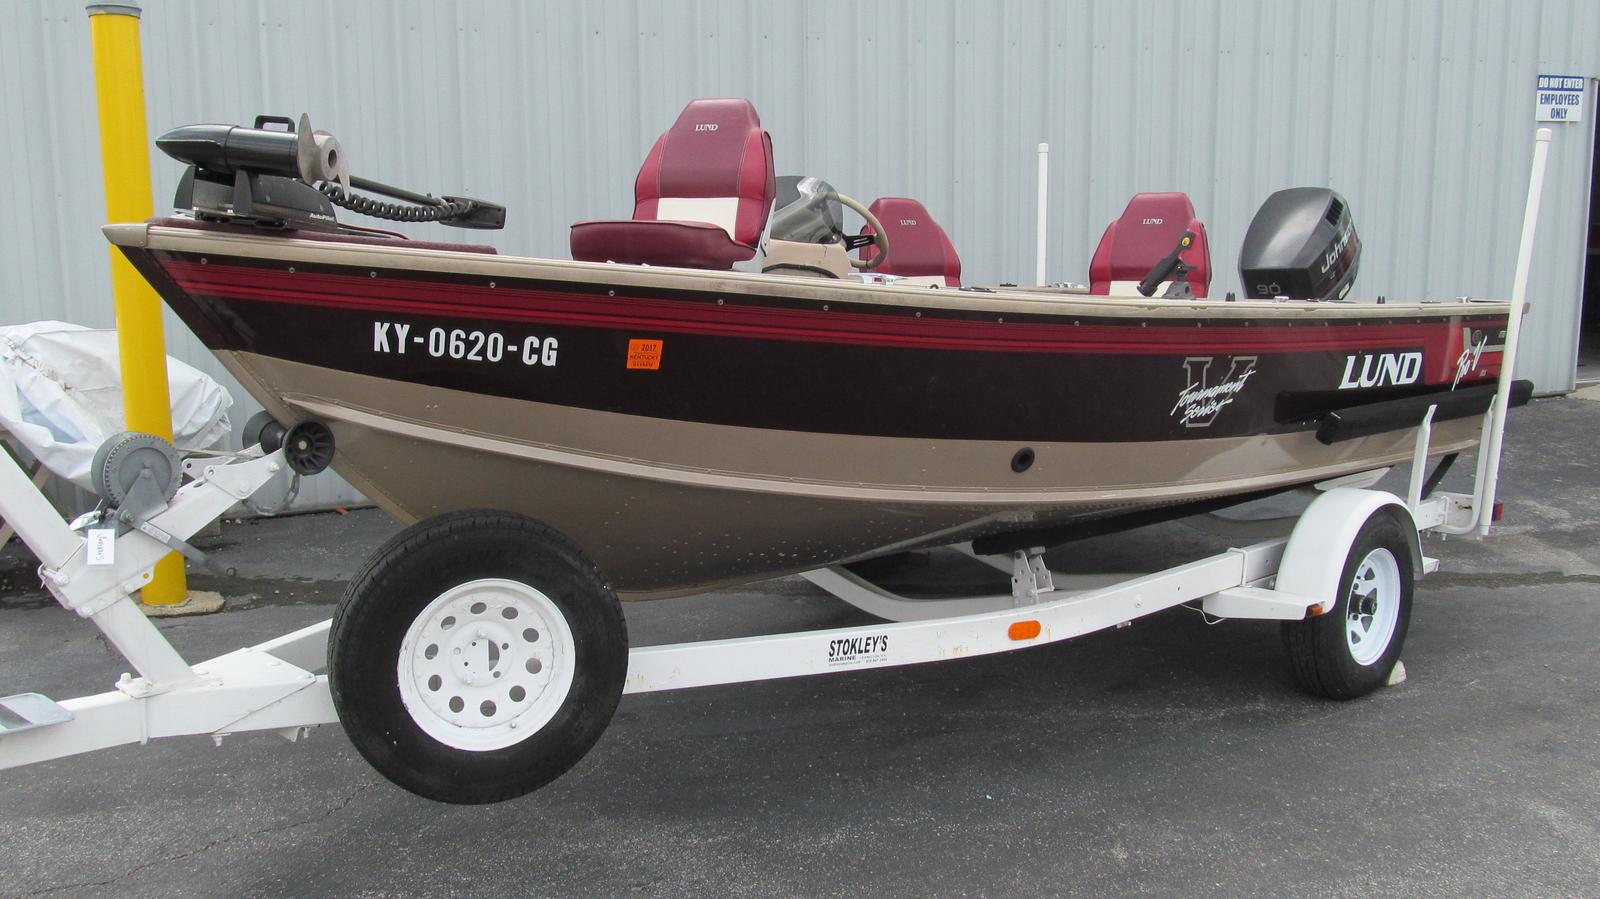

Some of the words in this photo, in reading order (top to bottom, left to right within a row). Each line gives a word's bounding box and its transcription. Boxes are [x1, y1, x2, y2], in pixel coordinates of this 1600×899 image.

[1538, 77, 1549, 88] DO
[1550, 77, 1563, 89] NOT
[1563, 78, 1582, 89] ENTER
[1540, 93, 1580, 105] EMPLOYEES
[1551, 107, 1568, 119] ONLY
[695, 123, 719, 131] LUND
[1257, 283, 1281, 295] 90
[373, 321, 559, 367] KY-0620-CG
[641, 343, 657, 352] 2017
[1338, 352, 1423, 390] LUND
[1170, 369, 1257, 416] Tournament
[1180, 398, 1234, 424] Series
[828, 634, 888, 658] STOKLEY'S
[828, 655, 856, 663] MARINE
